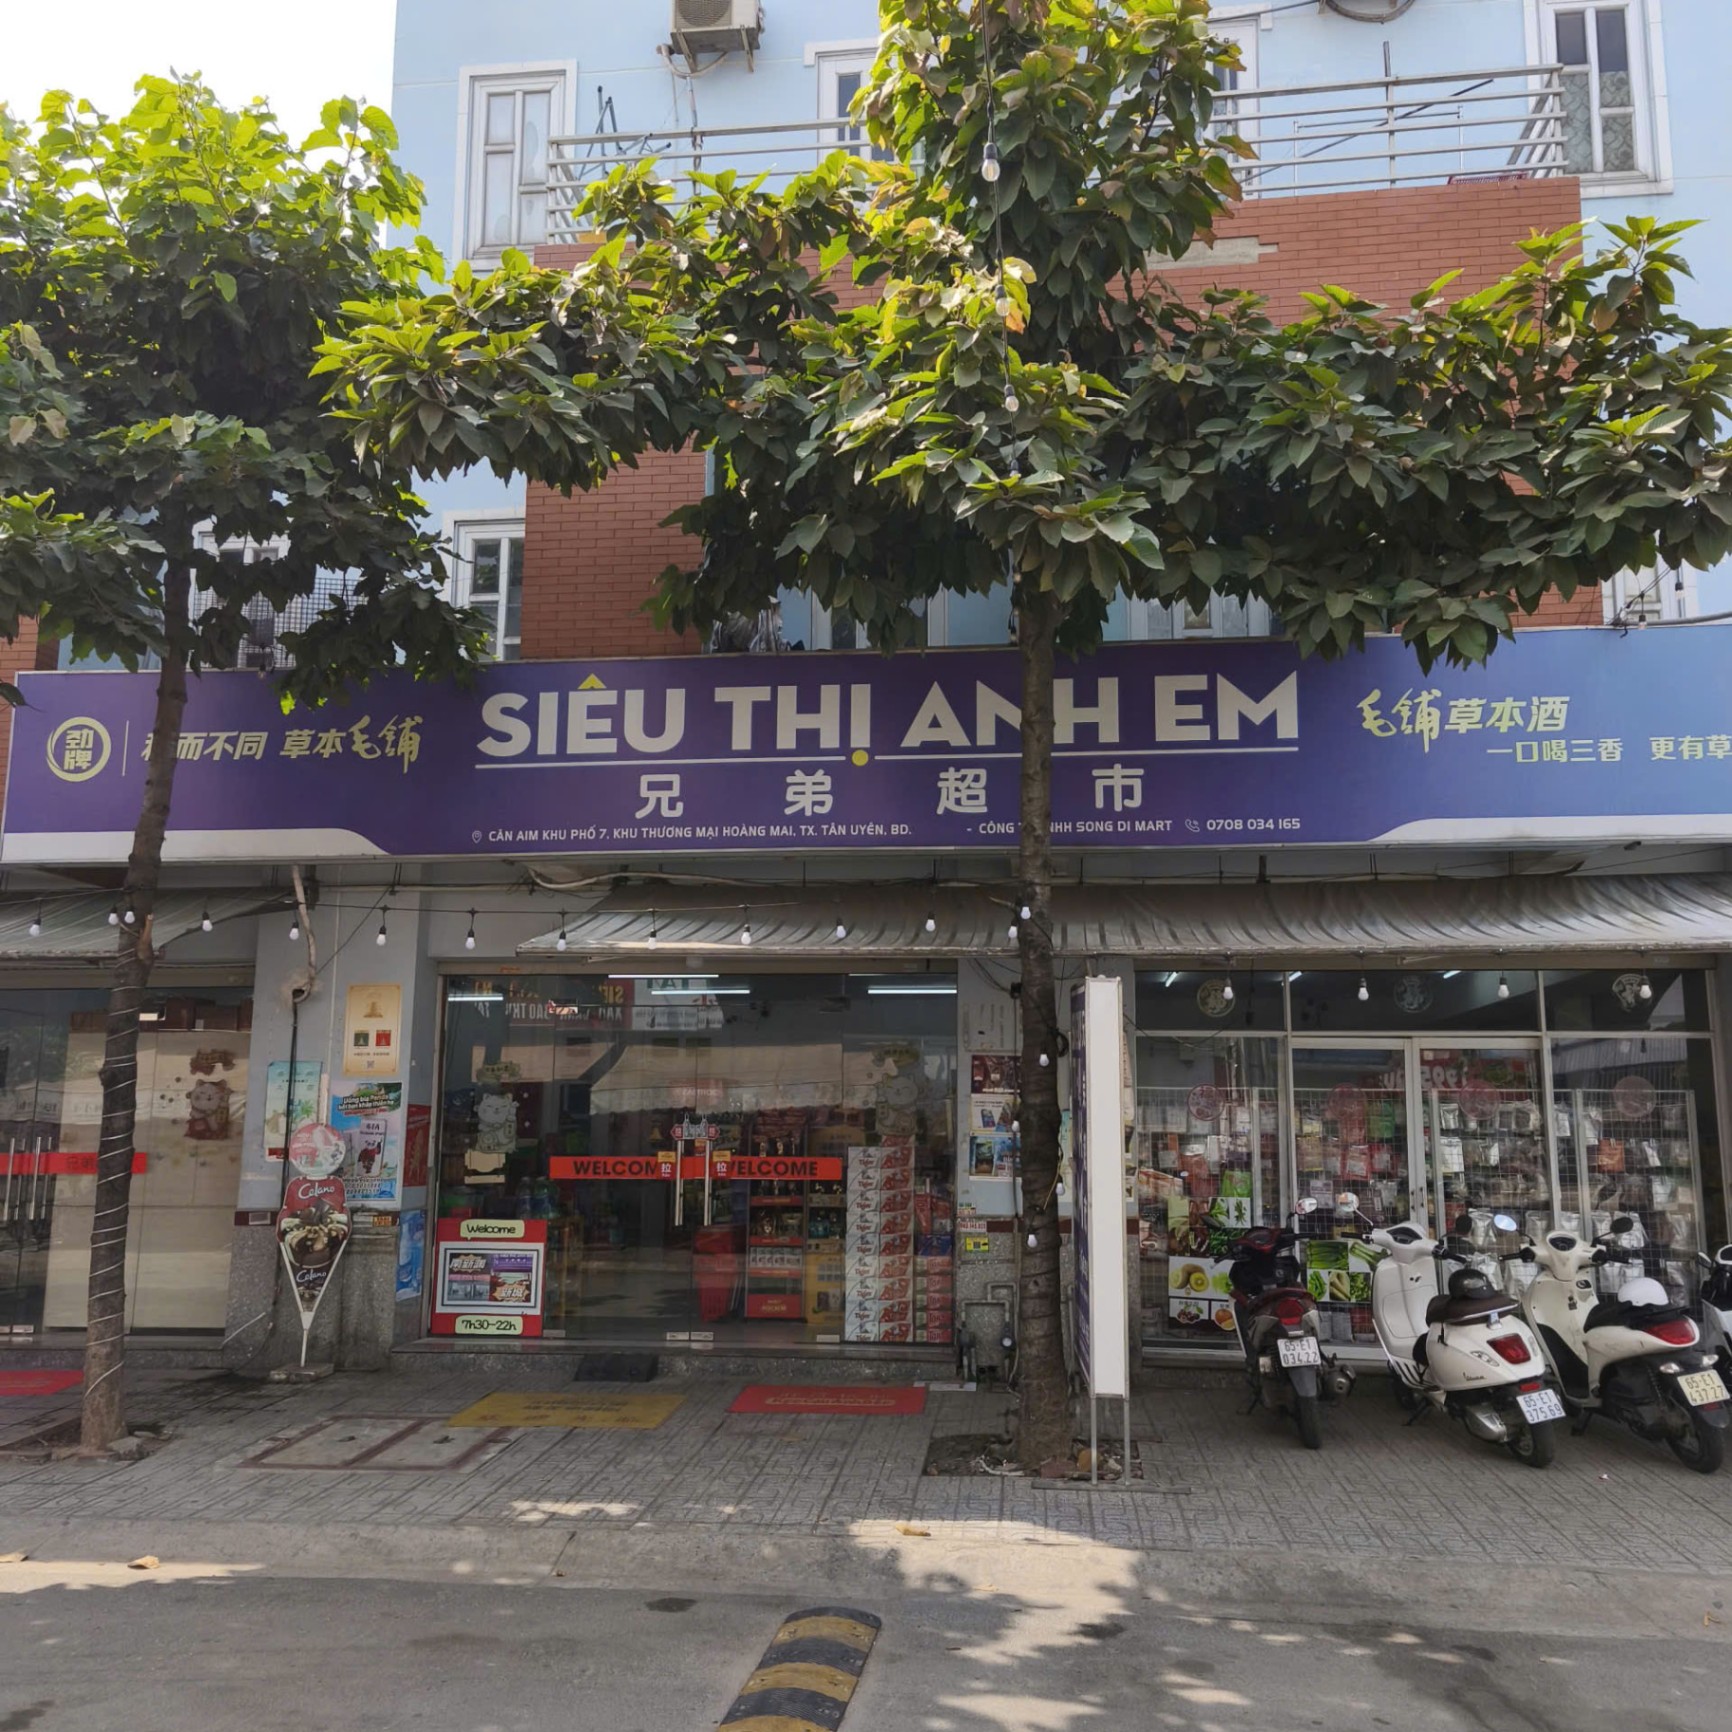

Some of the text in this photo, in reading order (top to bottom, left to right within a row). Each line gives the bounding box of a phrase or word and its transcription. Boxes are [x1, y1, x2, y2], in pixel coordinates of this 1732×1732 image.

[476, 670, 1299, 766] SIÊU THỊ ANH EM
[1486, 737, 1624, 763] 一口喝三香
[542, 829, 566, 841] KHU
[570, 824, 596, 840] PHỐ
[613, 828, 638, 839] KHU
[642, 826, 692, 839] THƯƠNG
[696, 826, 718, 840] MẠI
[722, 824, 766, 837] HOÀNG
[800, 825, 818, 836] TX.
[821, 822, 846, 836] TÂN
[890, 824, 912, 835] BD.
[978, 820, 1015, 834] CÔNG
[1076, 820, 1113, 832] SONG
[1117, 820, 1131, 832] DI
[1134, 820, 1173, 832] MART
[1206, 818, 1301, 831] 0708 034 165
[572, 1160, 657, 1175] WELCOM
[730, 1160, 818, 1176] ELCOME
[298, 1182, 335, 1200] Celano
[466, 1223, 517, 1234] Welcome
